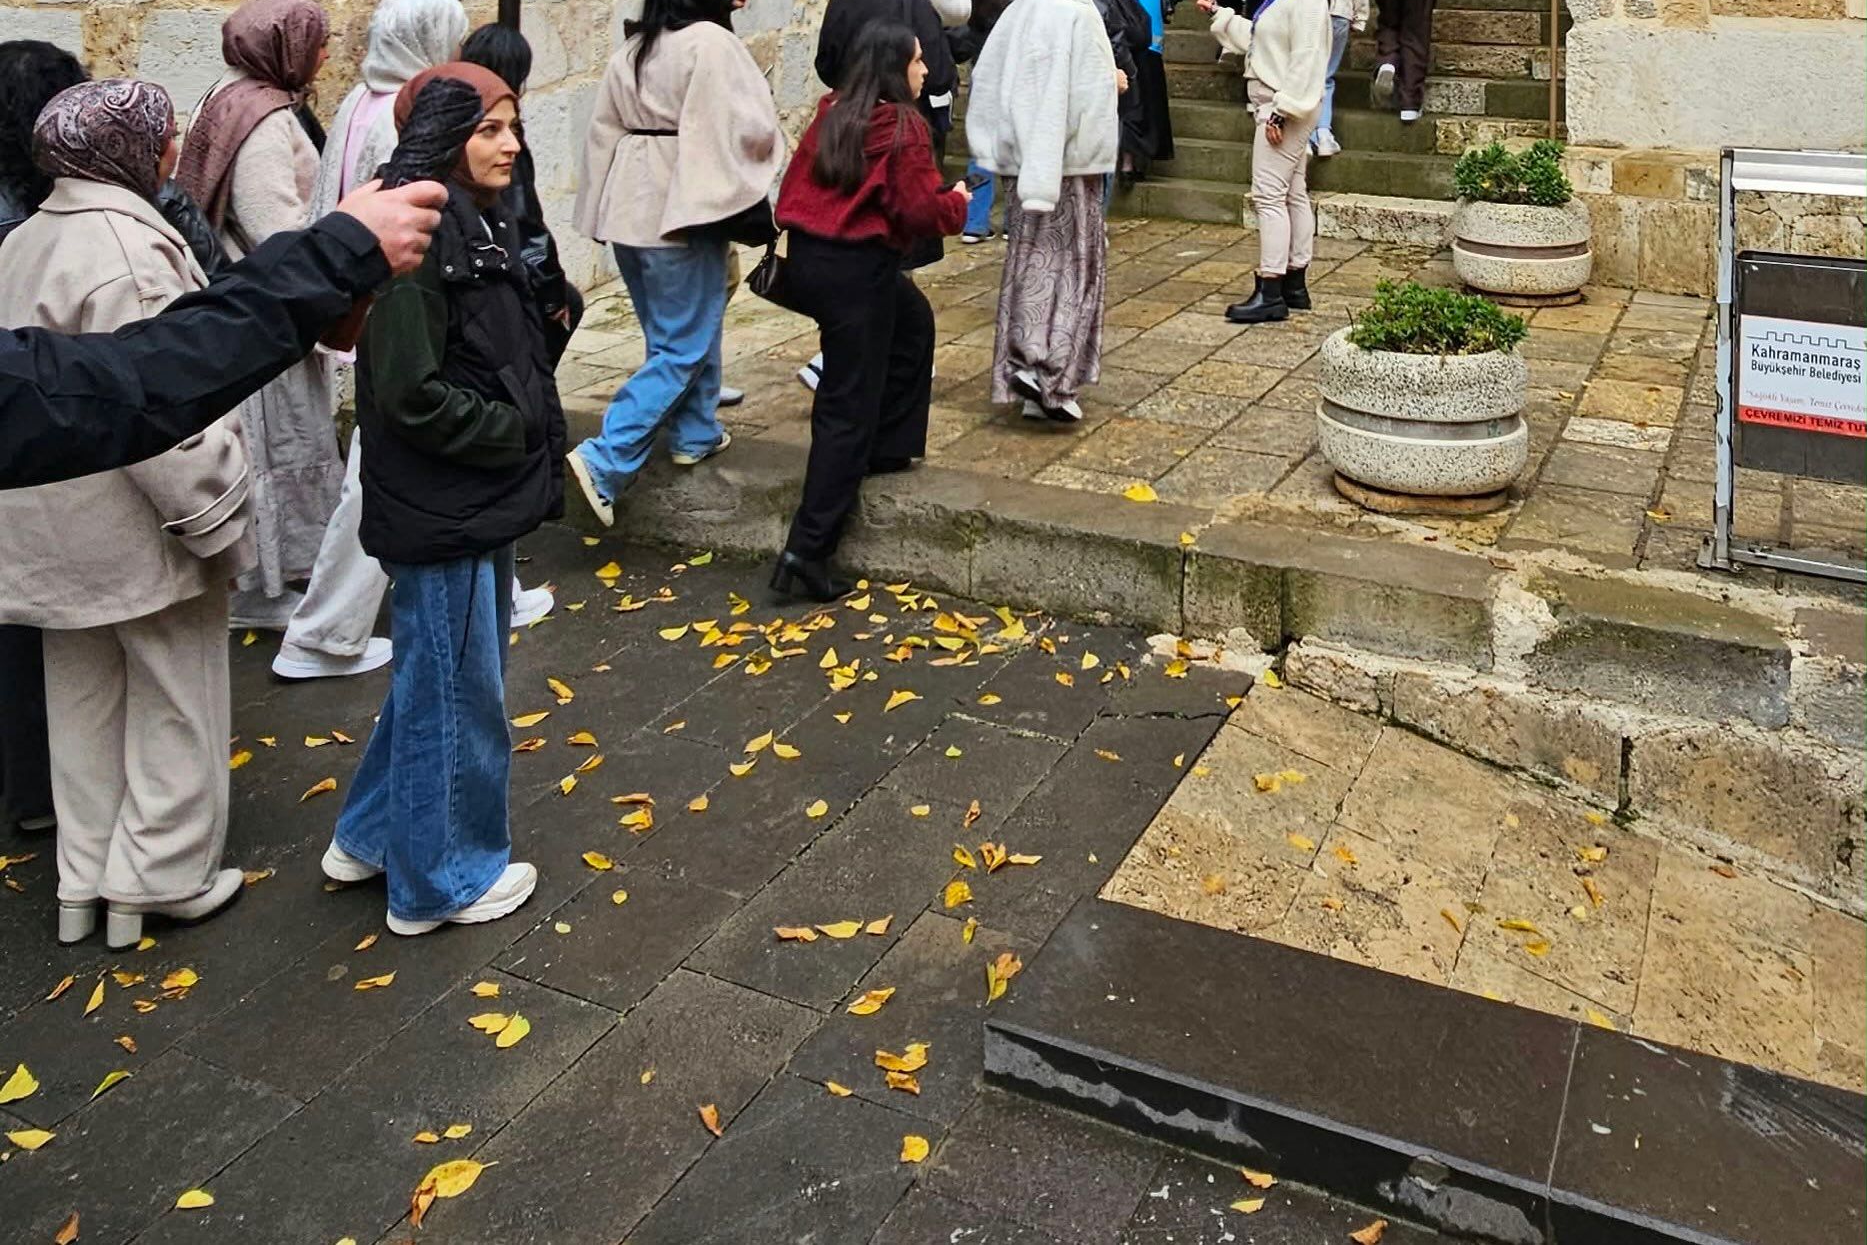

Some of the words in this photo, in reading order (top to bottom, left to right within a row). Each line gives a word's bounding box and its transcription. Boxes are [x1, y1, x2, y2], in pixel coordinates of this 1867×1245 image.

[1751, 343, 1861, 370] Kahramanmaraş
[1751, 359, 1807, 376] Büyükşehir
[1809, 366, 1862, 384] Belediyesi
